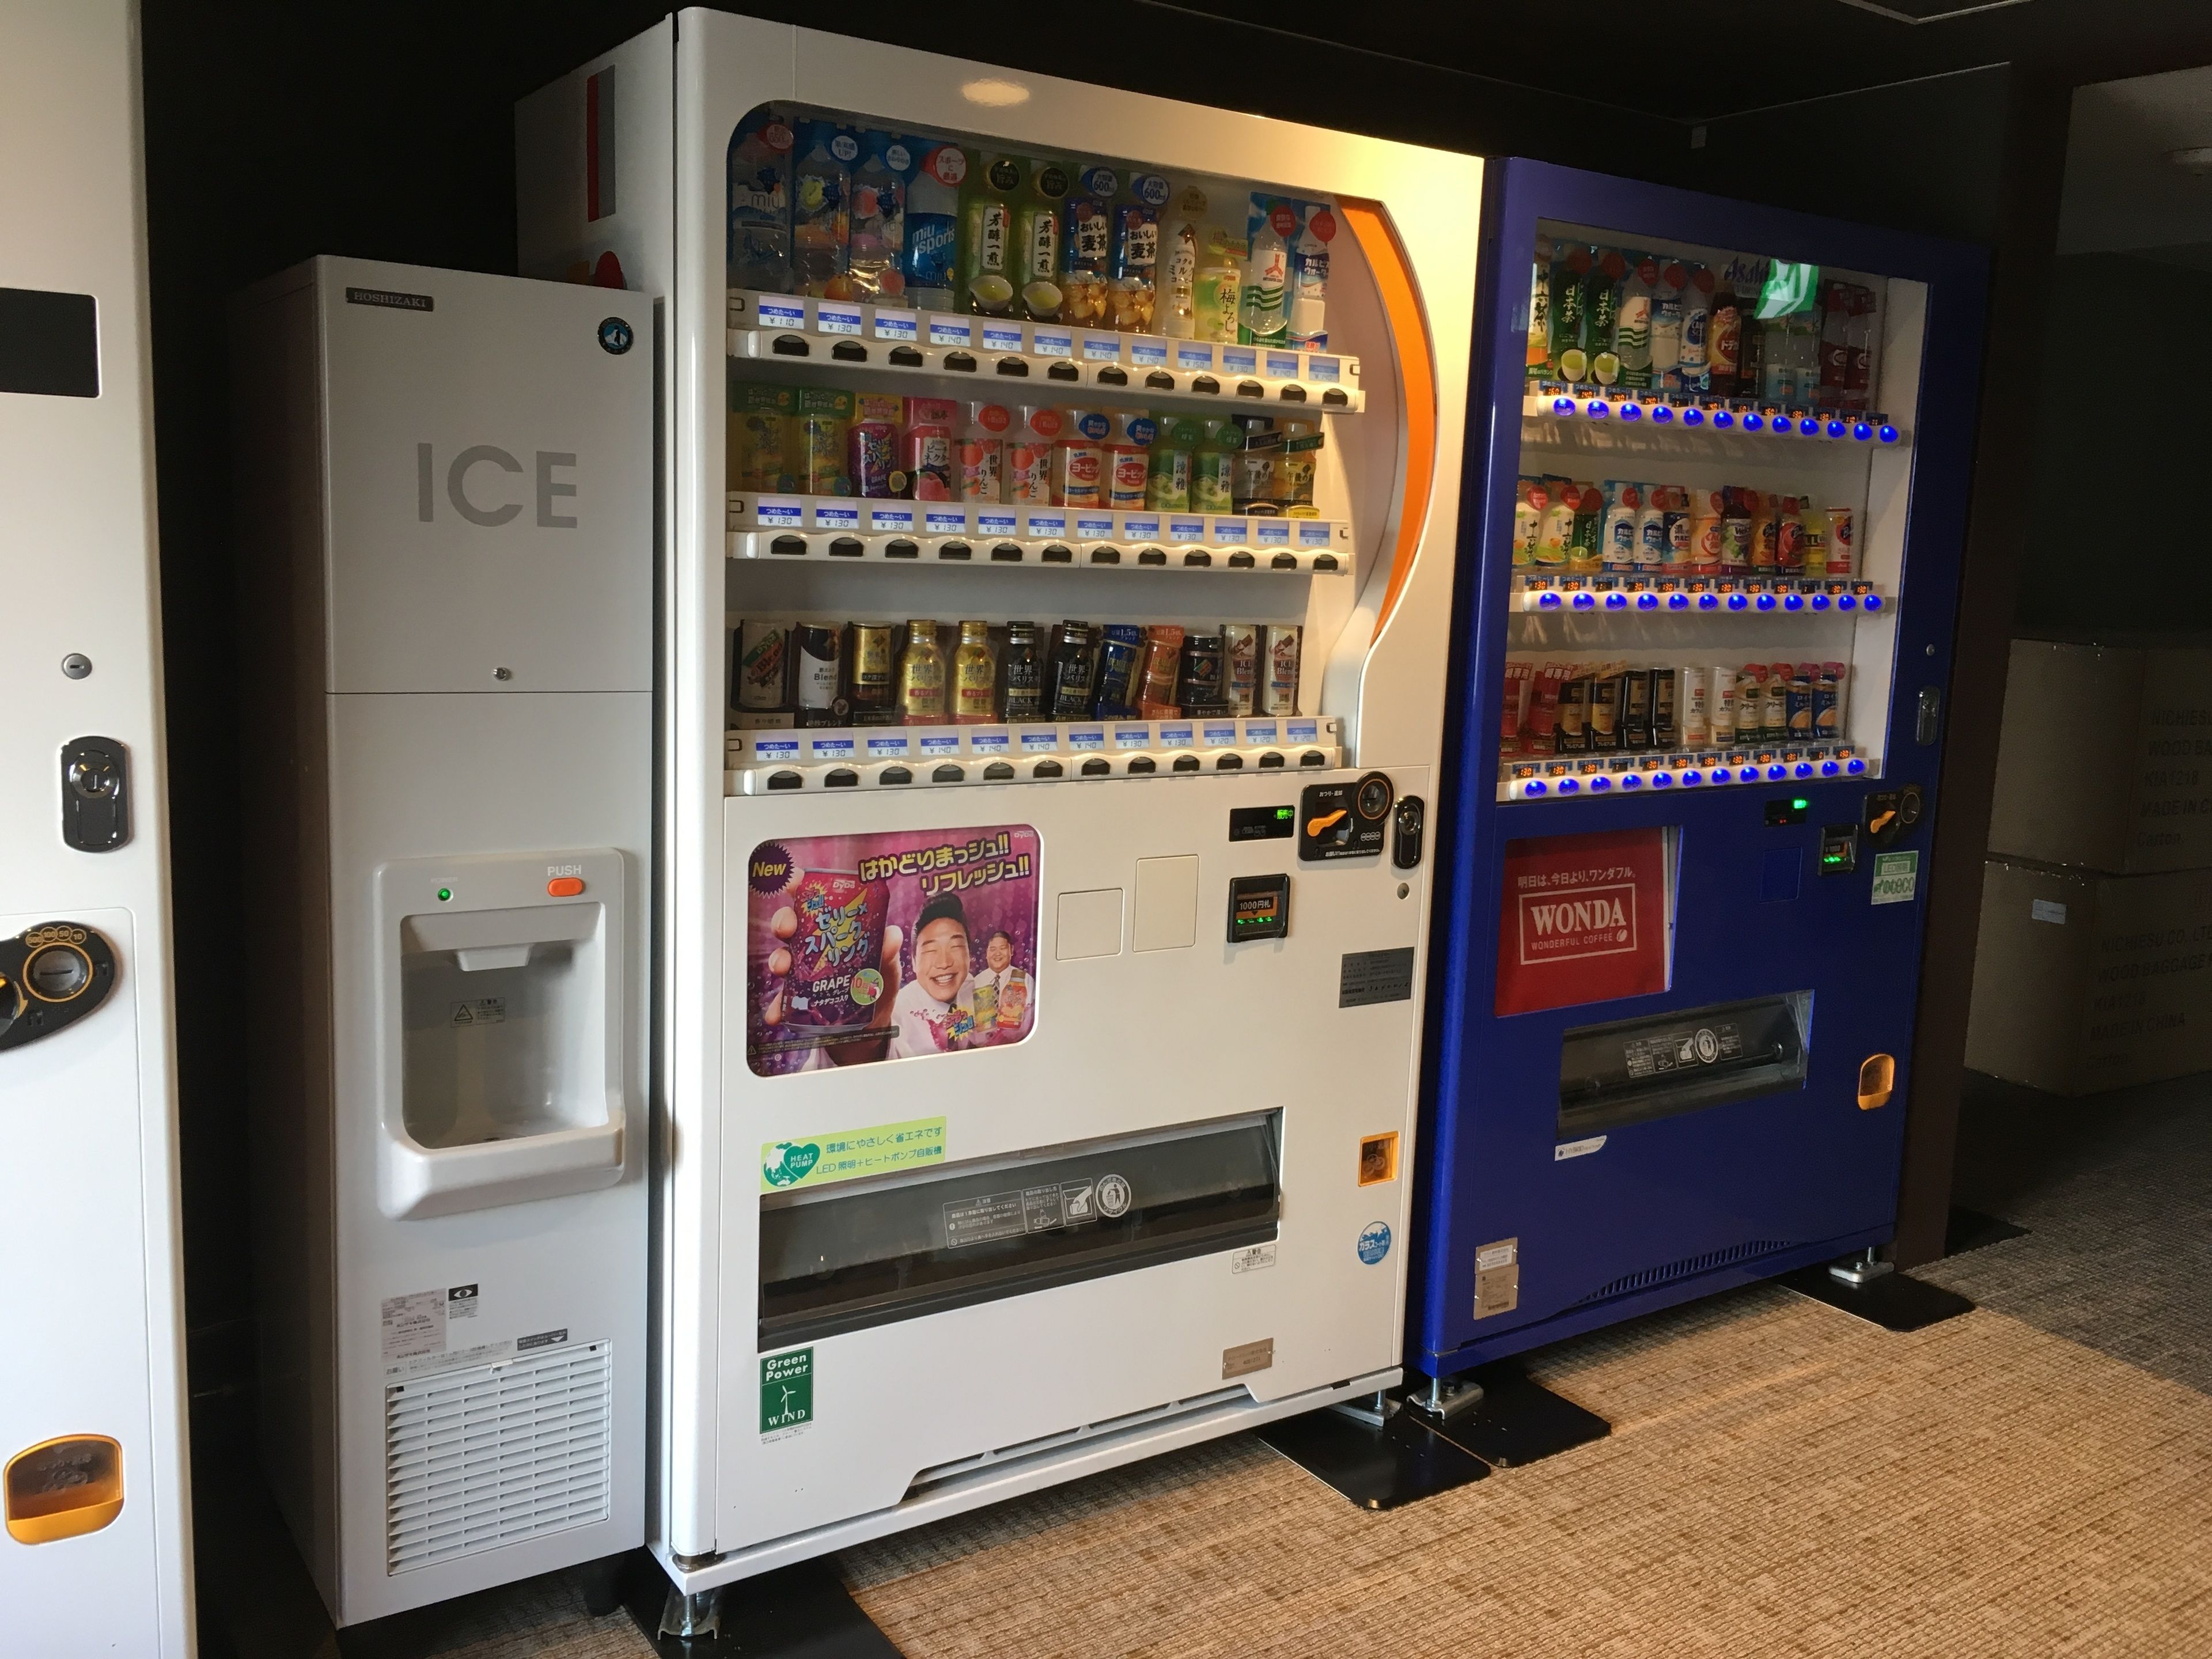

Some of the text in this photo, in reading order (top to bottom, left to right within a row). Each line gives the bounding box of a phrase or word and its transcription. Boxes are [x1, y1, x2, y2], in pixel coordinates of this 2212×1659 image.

[912, 224, 936, 243] miu
[354, 291, 426, 308] HOSHIZAKI
[1561, 285, 1577, 324] 日本茶
[1594, 289, 1611, 327] 日本茶
[418, 442, 578, 529] ICE
[547, 865, 582, 876] PUSH
[752, 862, 787, 877] New
[1531, 897, 1626, 936] WONDA
[1531, 933, 1613, 951] WONDERFUL COFFEE
[813, 975, 851, 993] GRAPE
[790, 1153, 813, 1162] HEAT
[790, 1159, 813, 1169] PUMP
[767, 1354, 806, 1370] Green
[766, 1364, 808, 1382] Power
[768, 1409, 806, 1427] WIND
